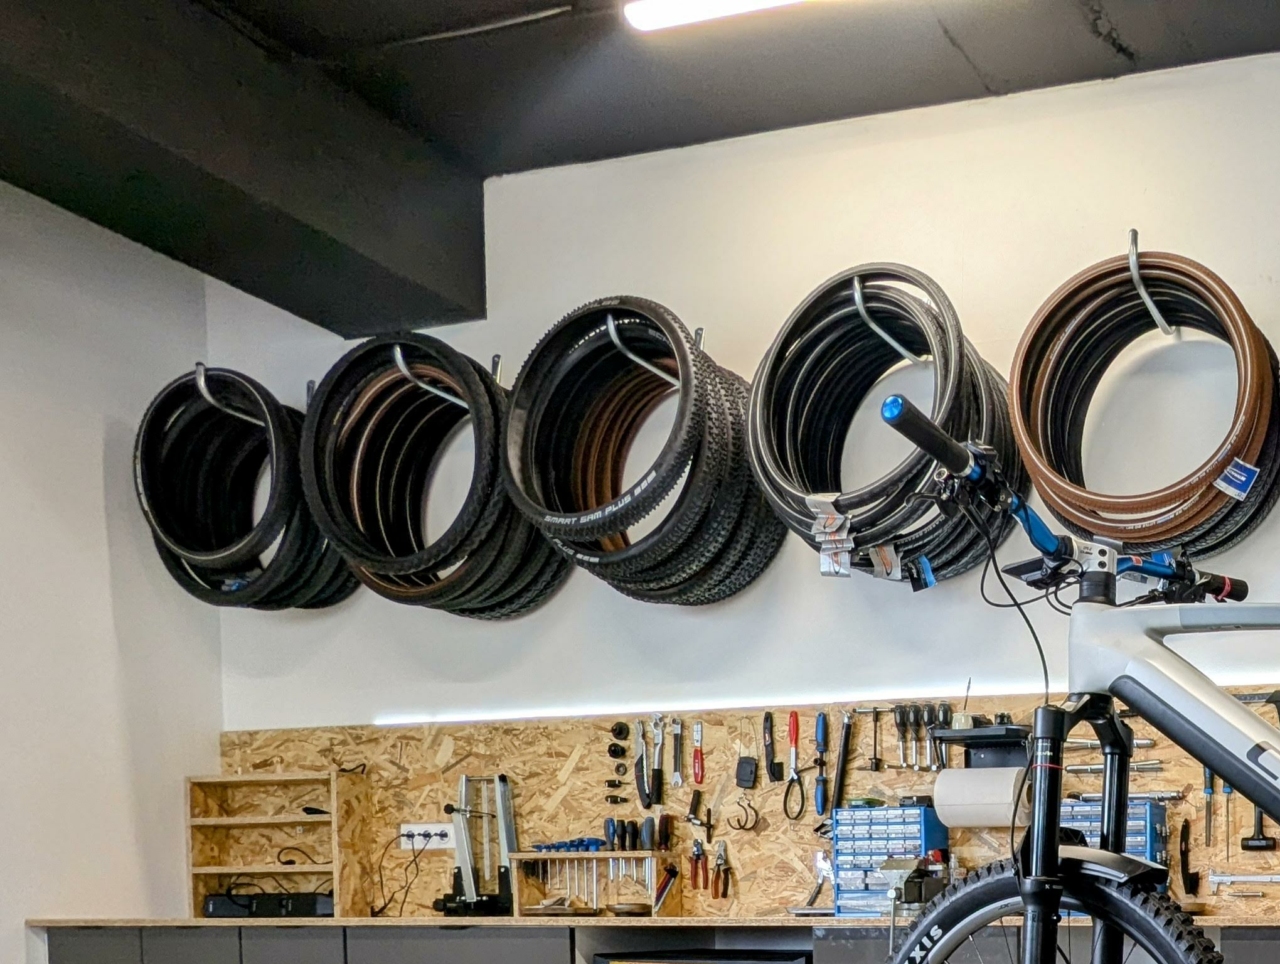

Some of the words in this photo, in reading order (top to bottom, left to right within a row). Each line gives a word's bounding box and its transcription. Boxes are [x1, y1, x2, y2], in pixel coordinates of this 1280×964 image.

[544, 515, 577, 525] SMART
[580, 511, 602, 523] SAM
[605, 494, 631, 516] PLUS
[553, 538, 575, 556] PLUS
